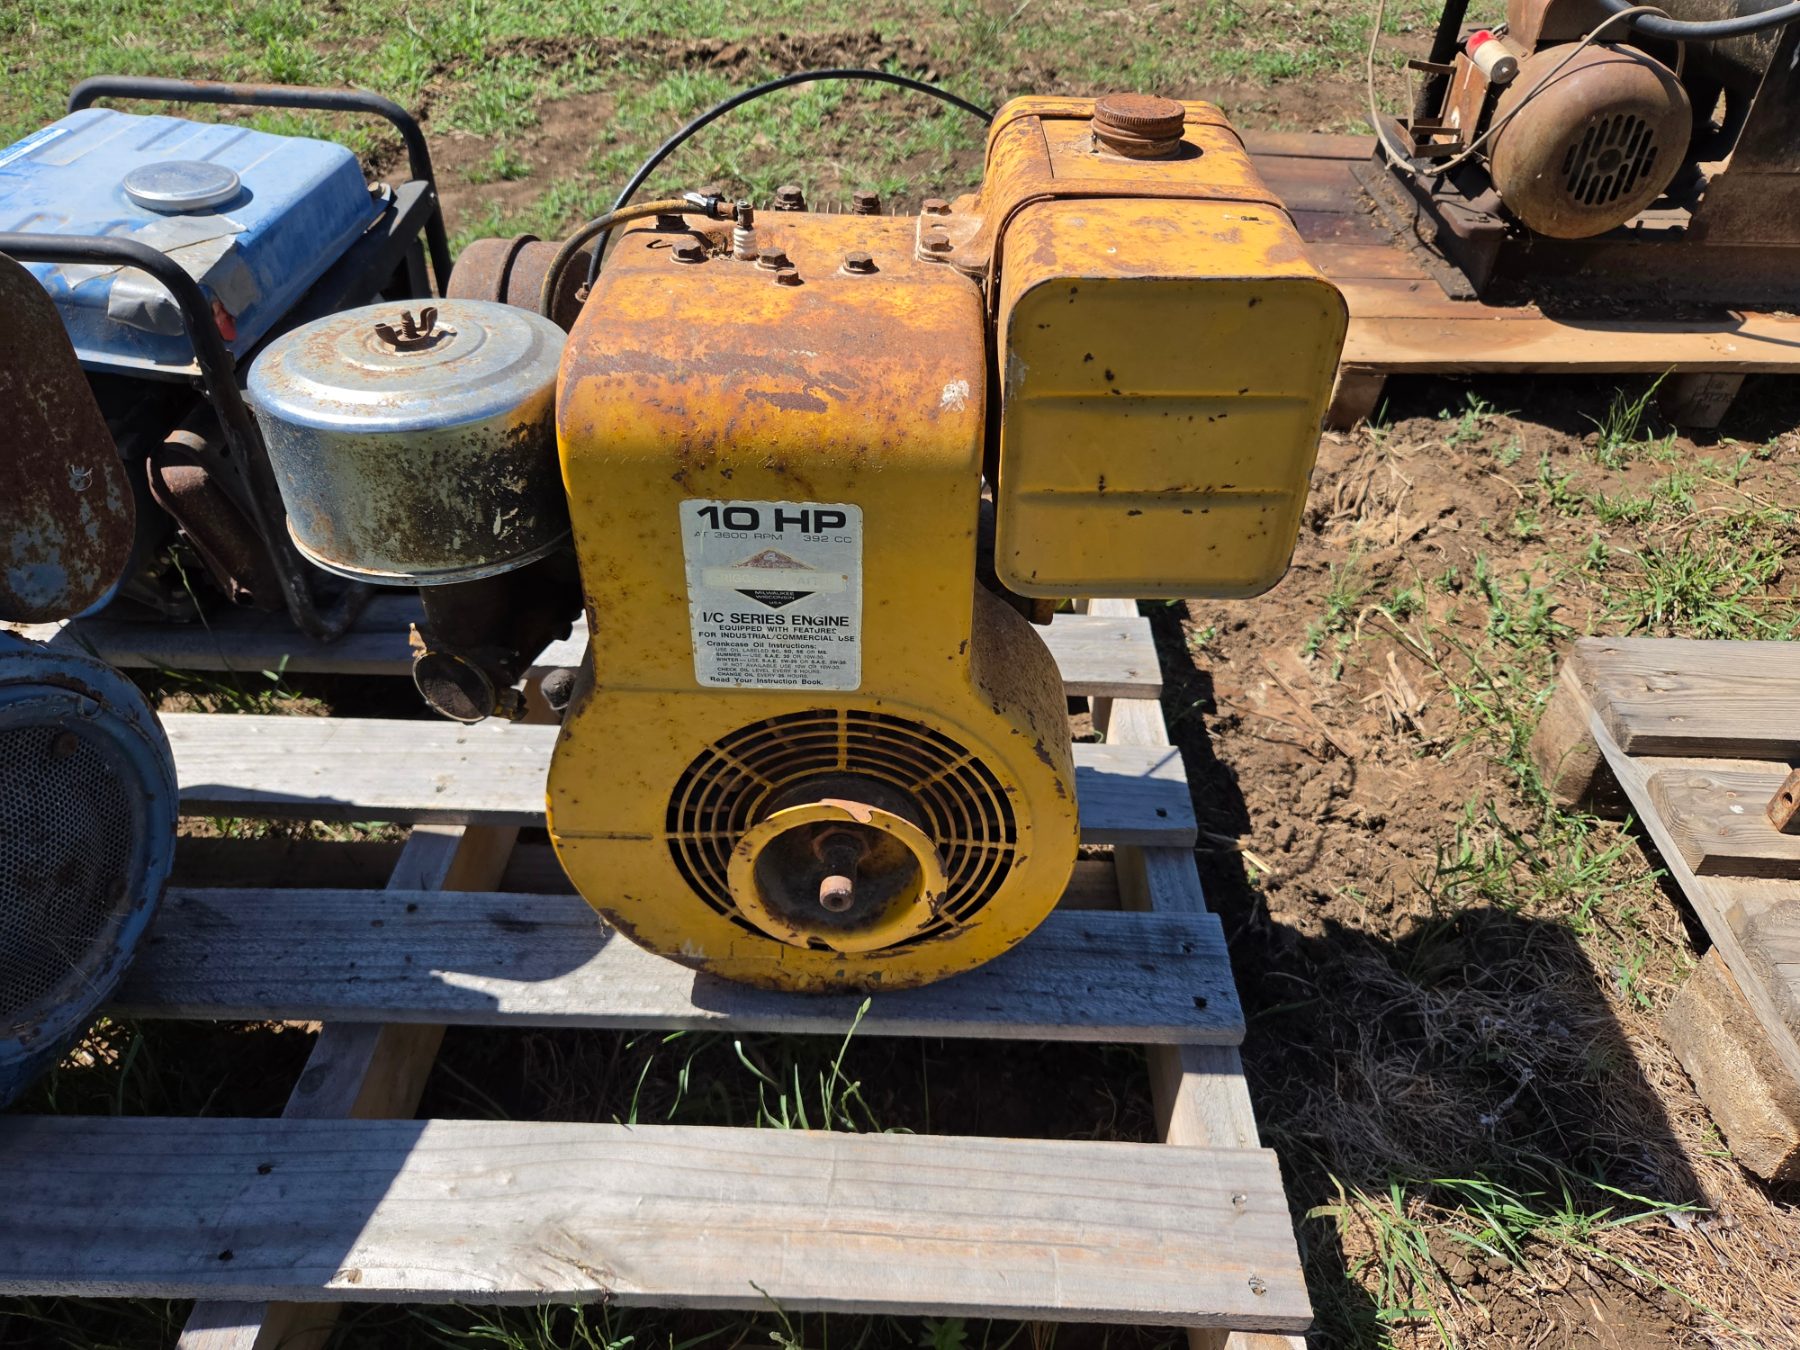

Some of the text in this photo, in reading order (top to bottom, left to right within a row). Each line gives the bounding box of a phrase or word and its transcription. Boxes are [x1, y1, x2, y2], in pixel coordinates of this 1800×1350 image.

[697, 506, 846, 533] 10 HP
[714, 531, 748, 539] 3600
[754, 533, 783, 541] RPM
[703, 611, 849, 627] I/C SERIES ENGINE
[721, 632, 834, 642] INDUSTRIAL/COMMERCIAL
[706, 640, 749, 648] Crankcase
[768, 642, 817, 650] Instructions:
